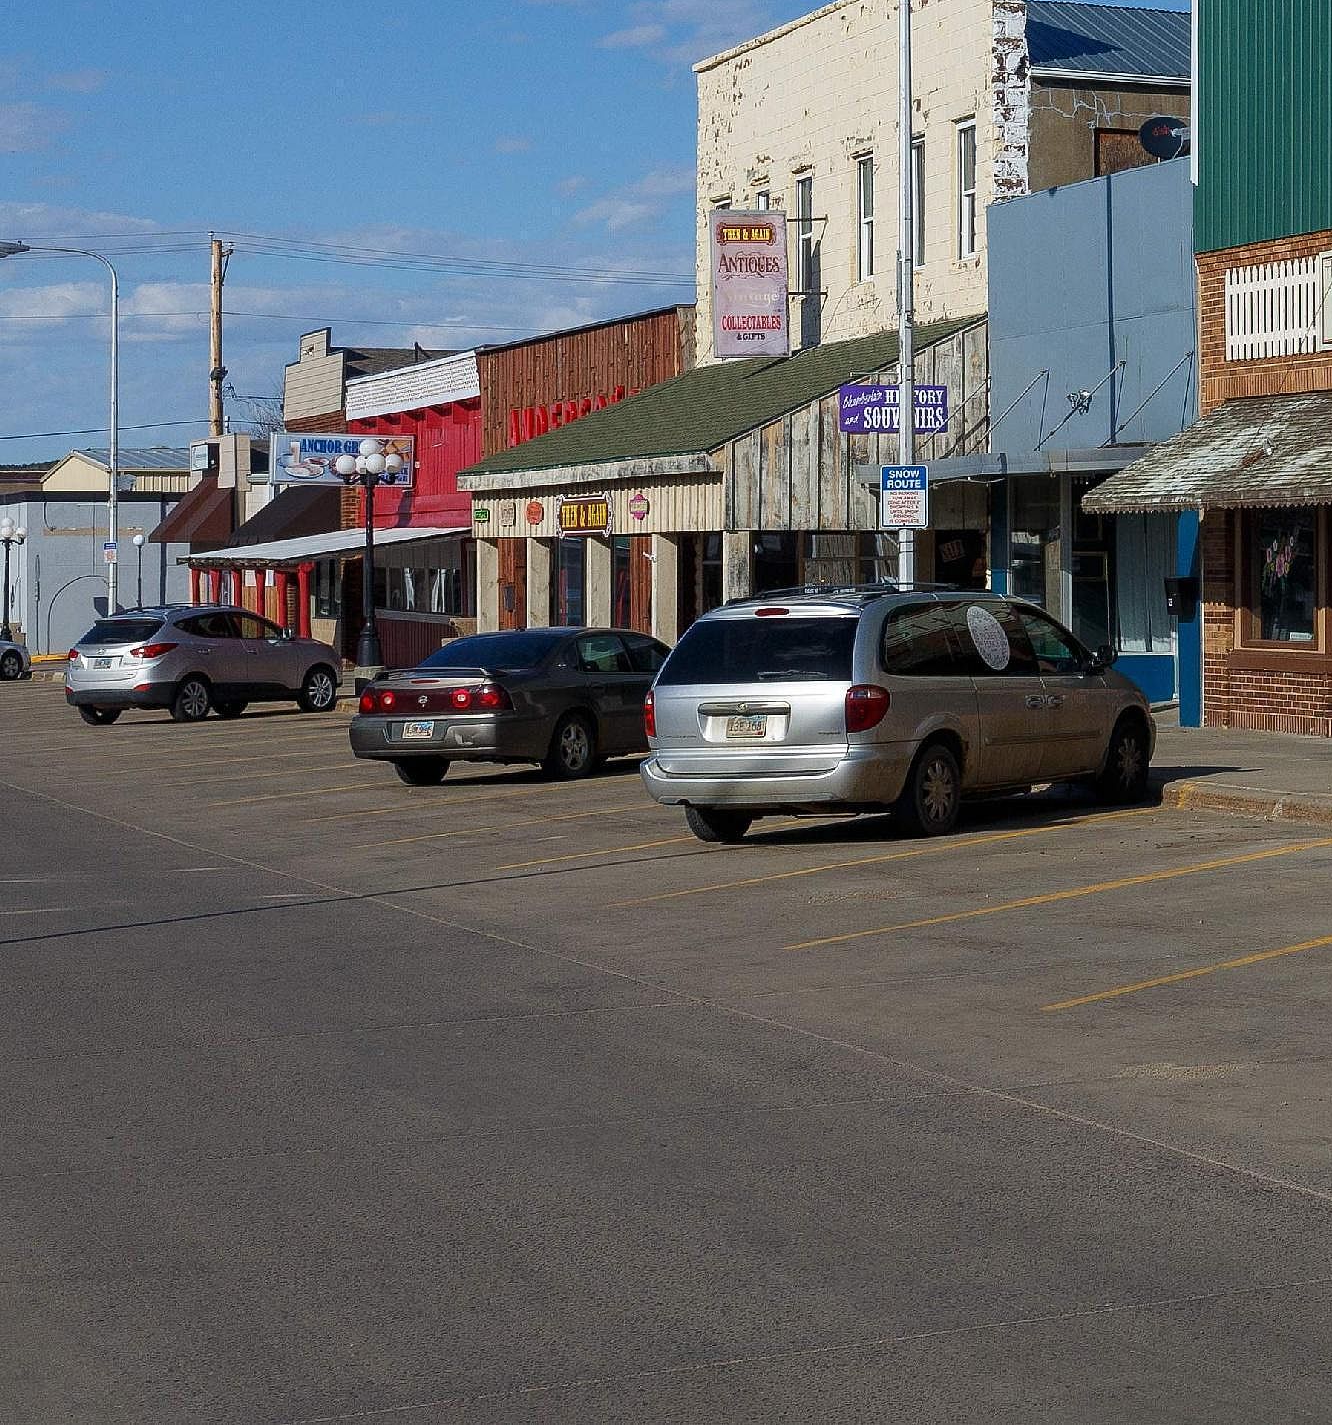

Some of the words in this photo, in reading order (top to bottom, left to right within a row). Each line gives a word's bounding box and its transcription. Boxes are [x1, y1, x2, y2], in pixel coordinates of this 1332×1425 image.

[722, 315, 782, 330] COLLECTABLES
[300, 438, 343, 454] ANCHOR
[888, 469, 920, 479] SNOW
[886, 479, 921, 489] ROUTE
[561, 504, 578, 528] THEN
[579, 505, 586, 527] &
[587, 503, 608, 527] AGAIN
